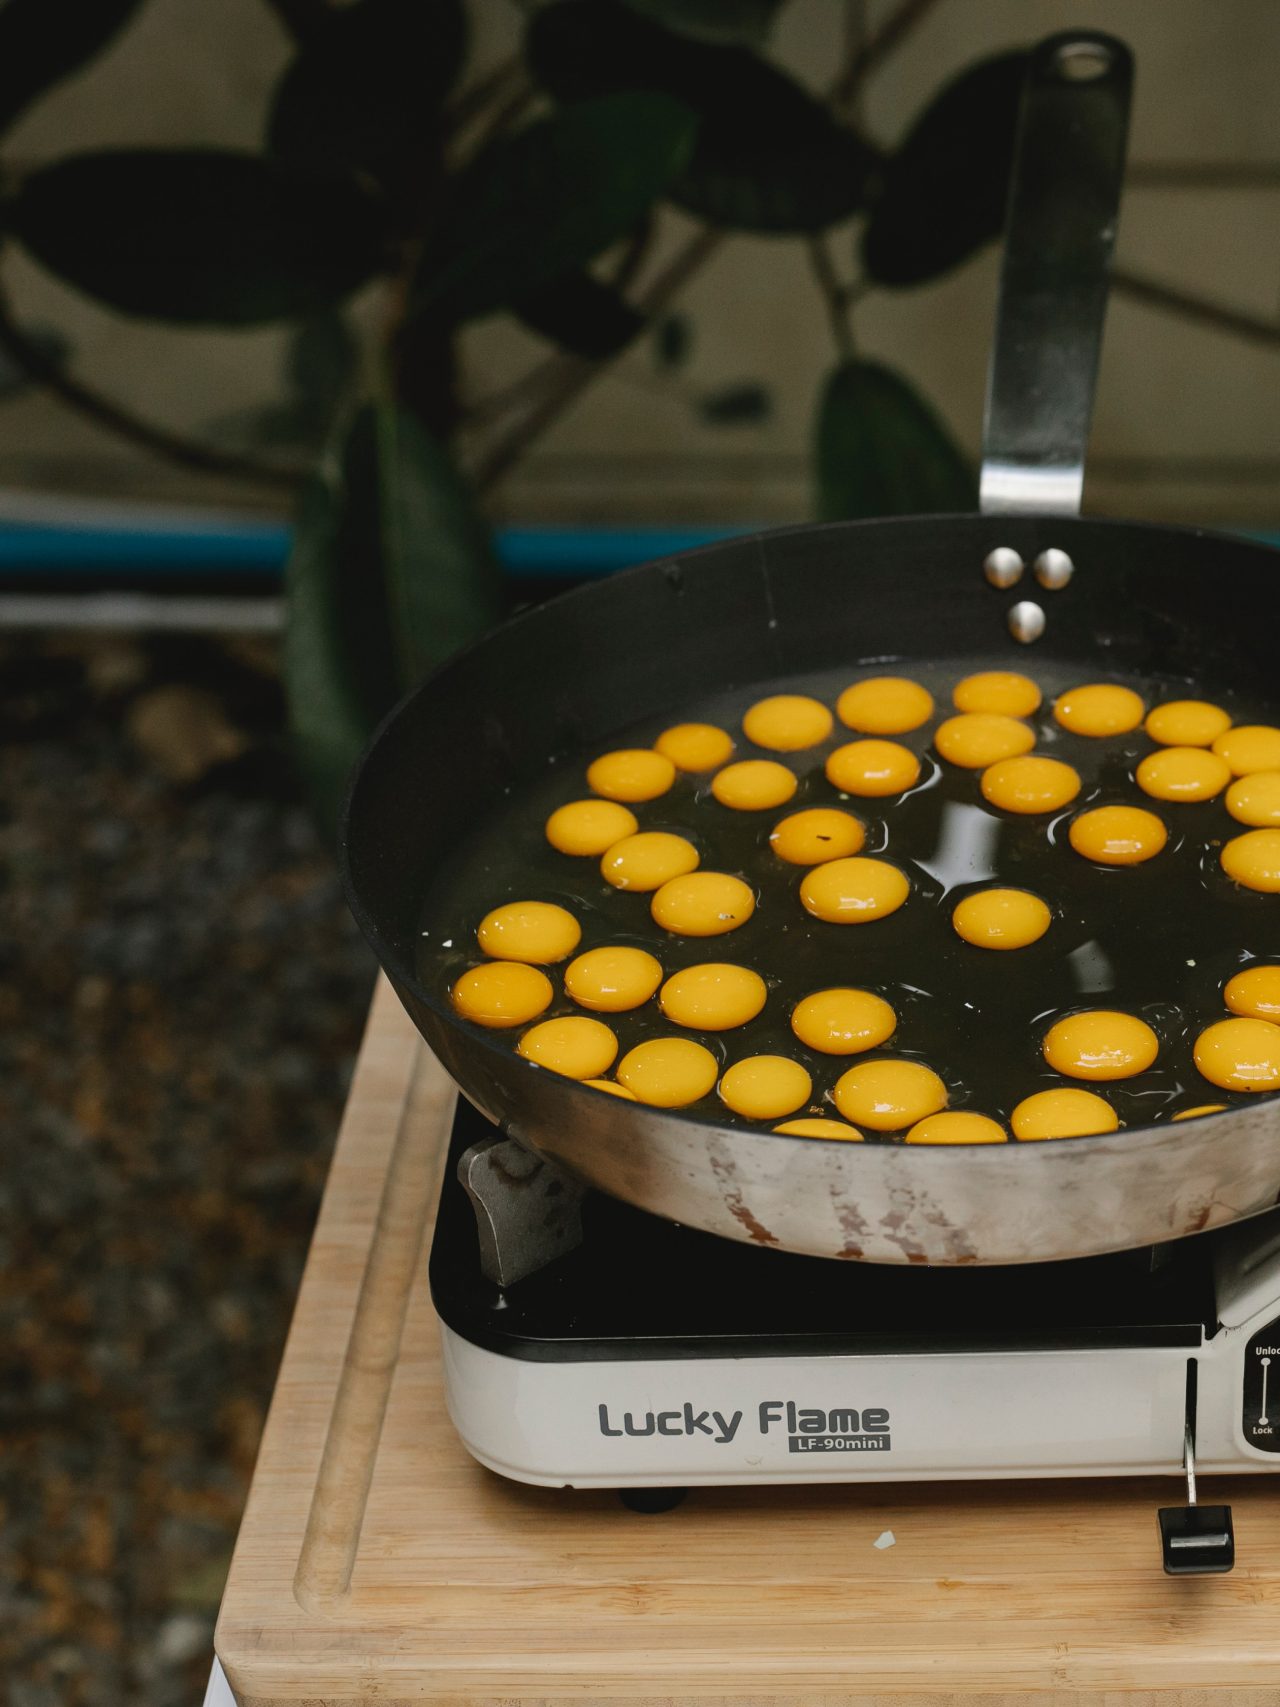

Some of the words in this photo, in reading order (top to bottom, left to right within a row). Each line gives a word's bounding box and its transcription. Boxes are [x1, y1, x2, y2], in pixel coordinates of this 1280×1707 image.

[598, 1402, 743, 1443] Lucky
[758, 1400, 890, 1434] Flame
[1252, 1426, 1273, 1435] Lock
[797, 1436, 884, 1450] LF-90mini
